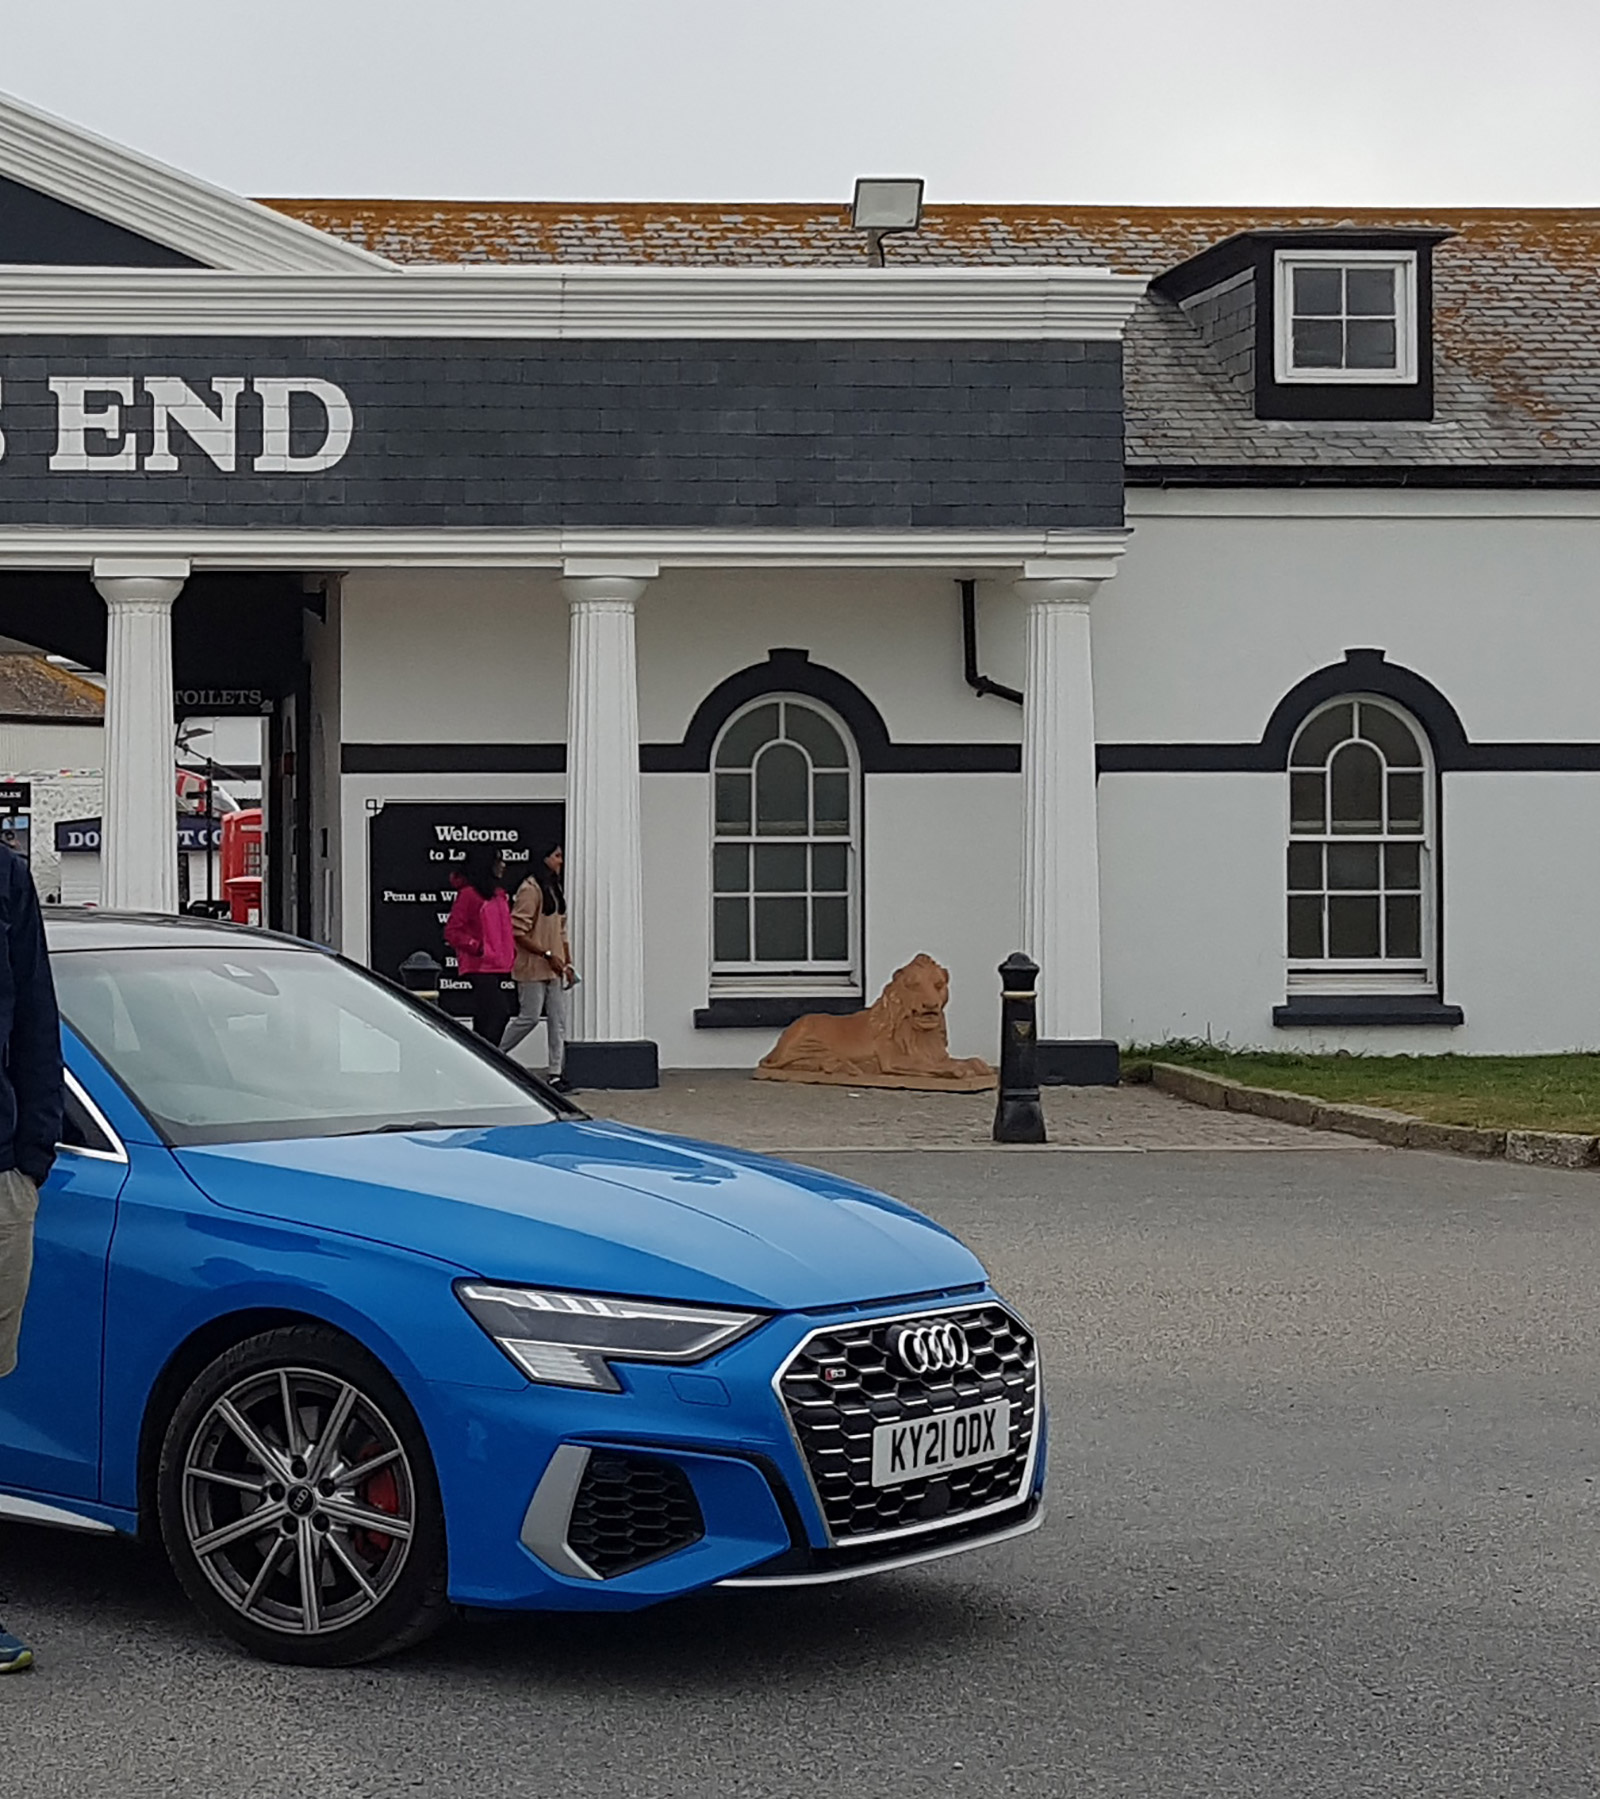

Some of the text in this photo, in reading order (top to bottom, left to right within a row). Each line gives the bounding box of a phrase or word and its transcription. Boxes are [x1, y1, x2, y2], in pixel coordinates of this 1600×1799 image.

[48, 376, 354, 472] END
[175, 689, 262, 705] TOILETS
[434, 825, 519, 841] Welcome
[429, 849, 445, 861] to
[501, 848, 530, 861] End
[419, 892, 437, 902] an
[890, 1421, 947, 1474] KY21
